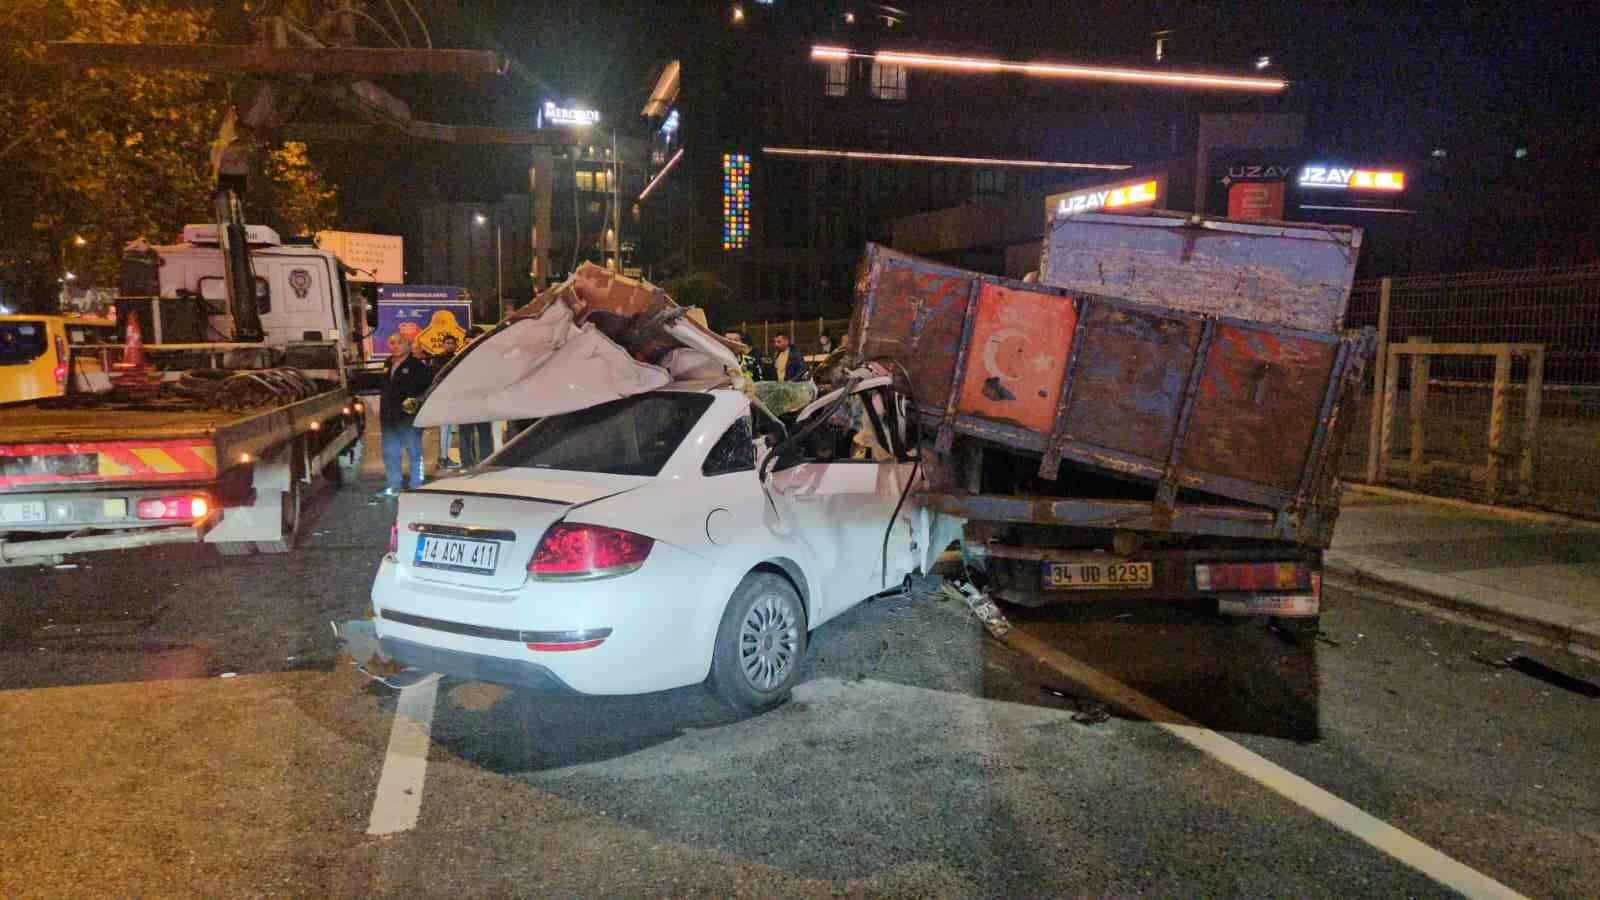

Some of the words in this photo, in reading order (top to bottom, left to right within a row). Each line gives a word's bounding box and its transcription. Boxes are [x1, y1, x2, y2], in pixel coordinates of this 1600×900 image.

[1229, 165, 1290, 178] UZAY
[1059, 190, 1111, 213] UZAY
[424, 540, 439, 560] 14
[442, 542, 466, 563] ACN
[471, 545, 494, 569] 411
[1053, 566, 1073, 583] 34
[1081, 566, 1100, 583] UD
[1108, 564, 1150, 582] 8293
